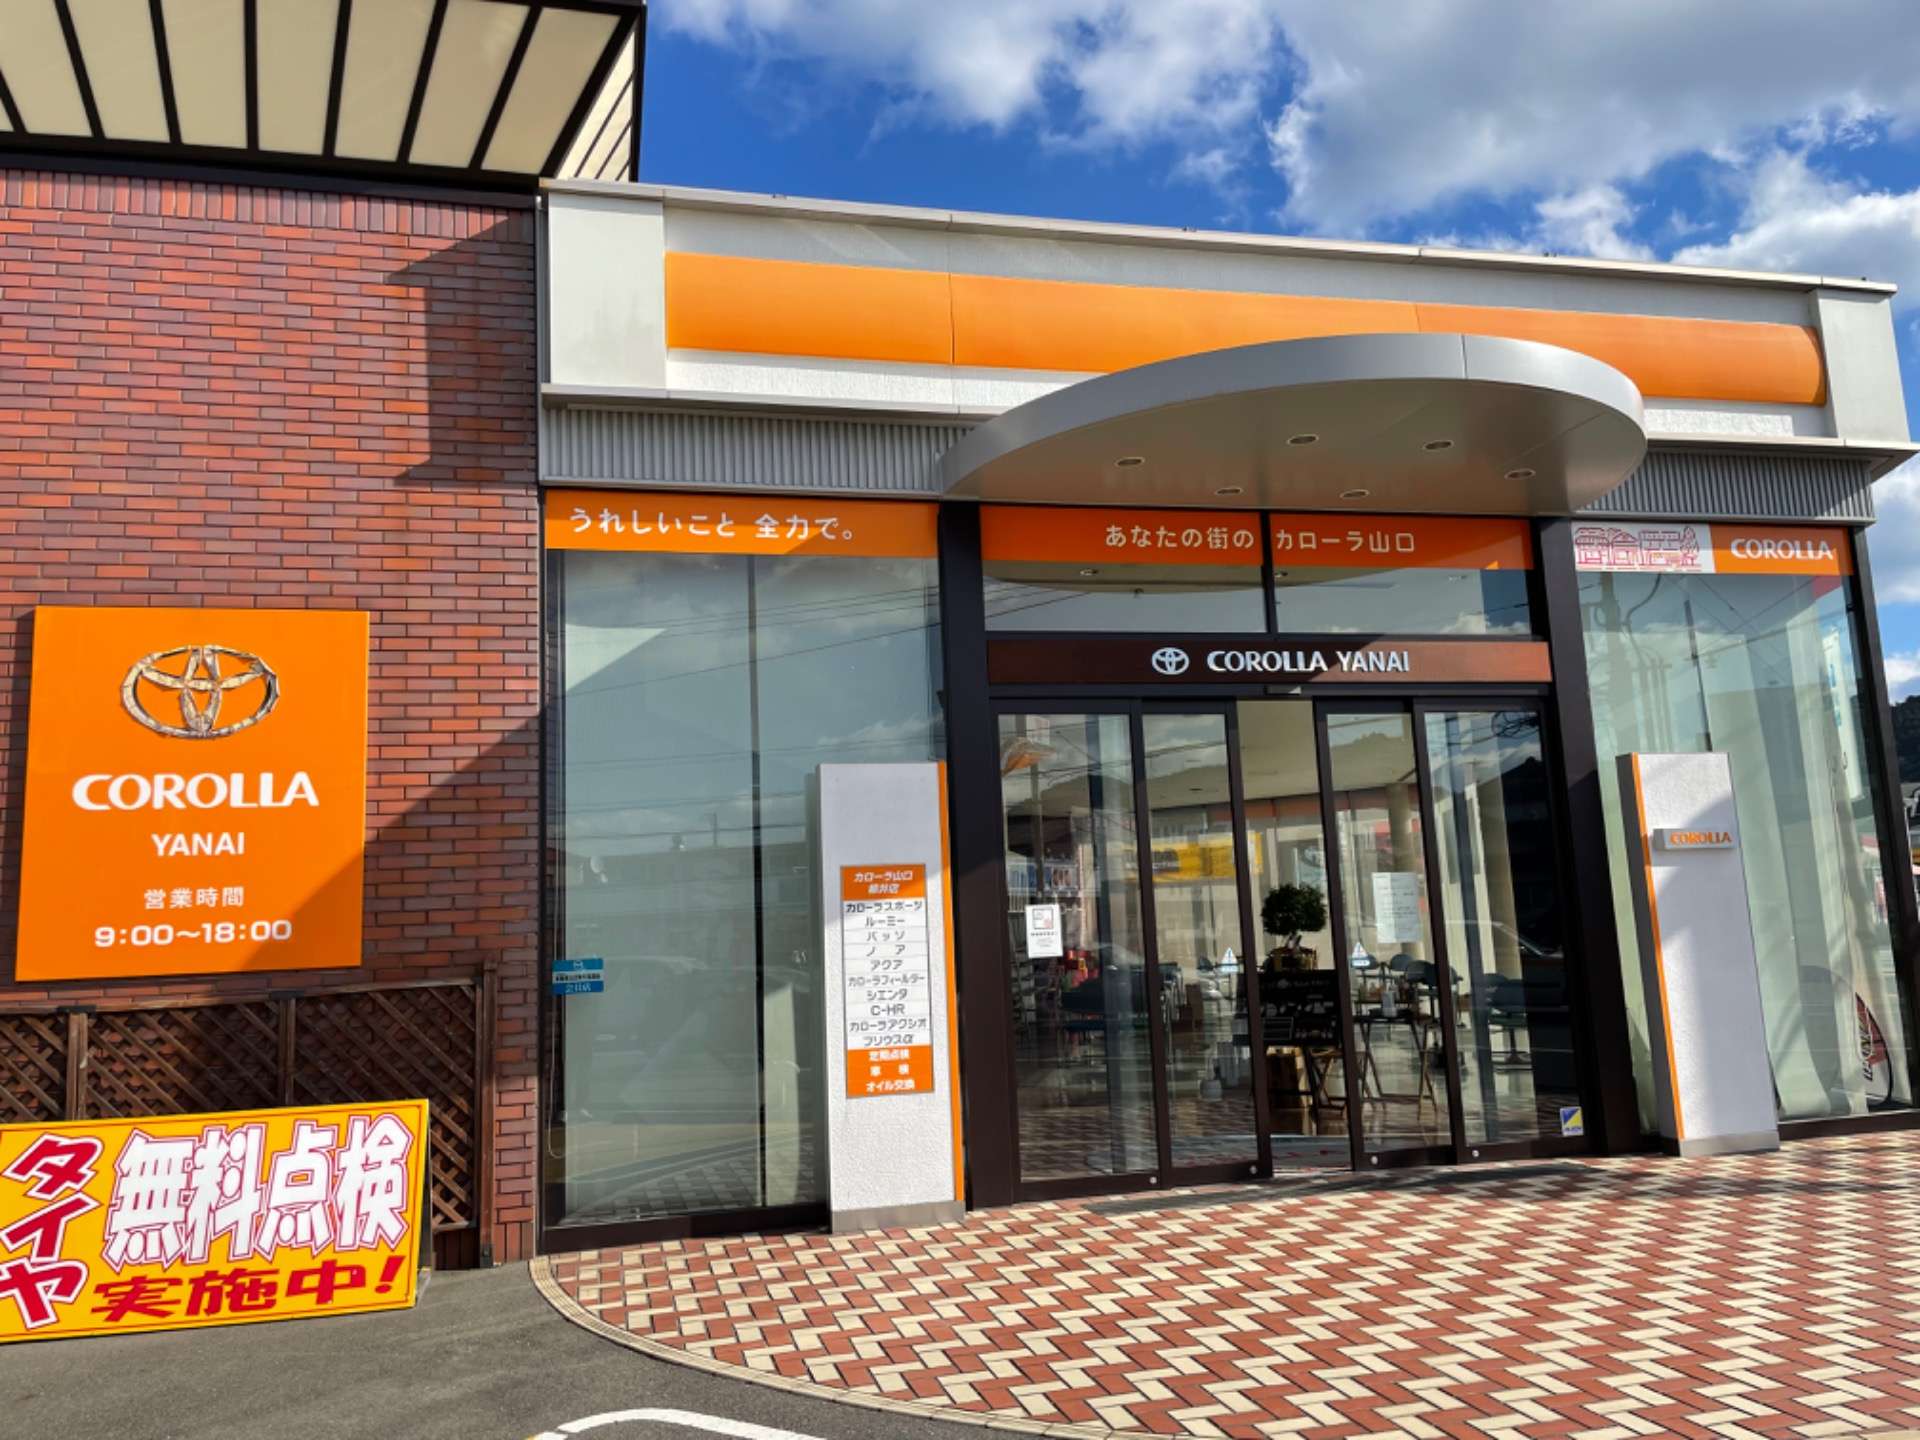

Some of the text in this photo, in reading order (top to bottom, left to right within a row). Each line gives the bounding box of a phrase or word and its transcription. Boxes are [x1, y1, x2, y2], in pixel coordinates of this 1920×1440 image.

[569, 507, 852, 540] うれしいこと 全力で。
[1105, 525, 1415, 553] あなたの街の カローラ山口
[1730, 538, 1834, 561] COROLLA
[1206, 650, 1410, 673] COROLLA YANAI
[71, 771, 320, 811] COROLLA
[151, 832, 246, 857] YANAI
[1669, 830, 1732, 846] COROLLA
[144, 886, 245, 911] 営業時間
[865, 915, 905, 927] ルーミー
[870, 959, 903, 971] アクア
[866, 988, 908, 1001] シエンタ
[870, 1003, 905, 1016] C-HR
[103, 1113, 413, 1274] 無料点検
[0, 1133, 103, 1329] タイヤ
[91, 1254, 407, 1322] 実施中!
